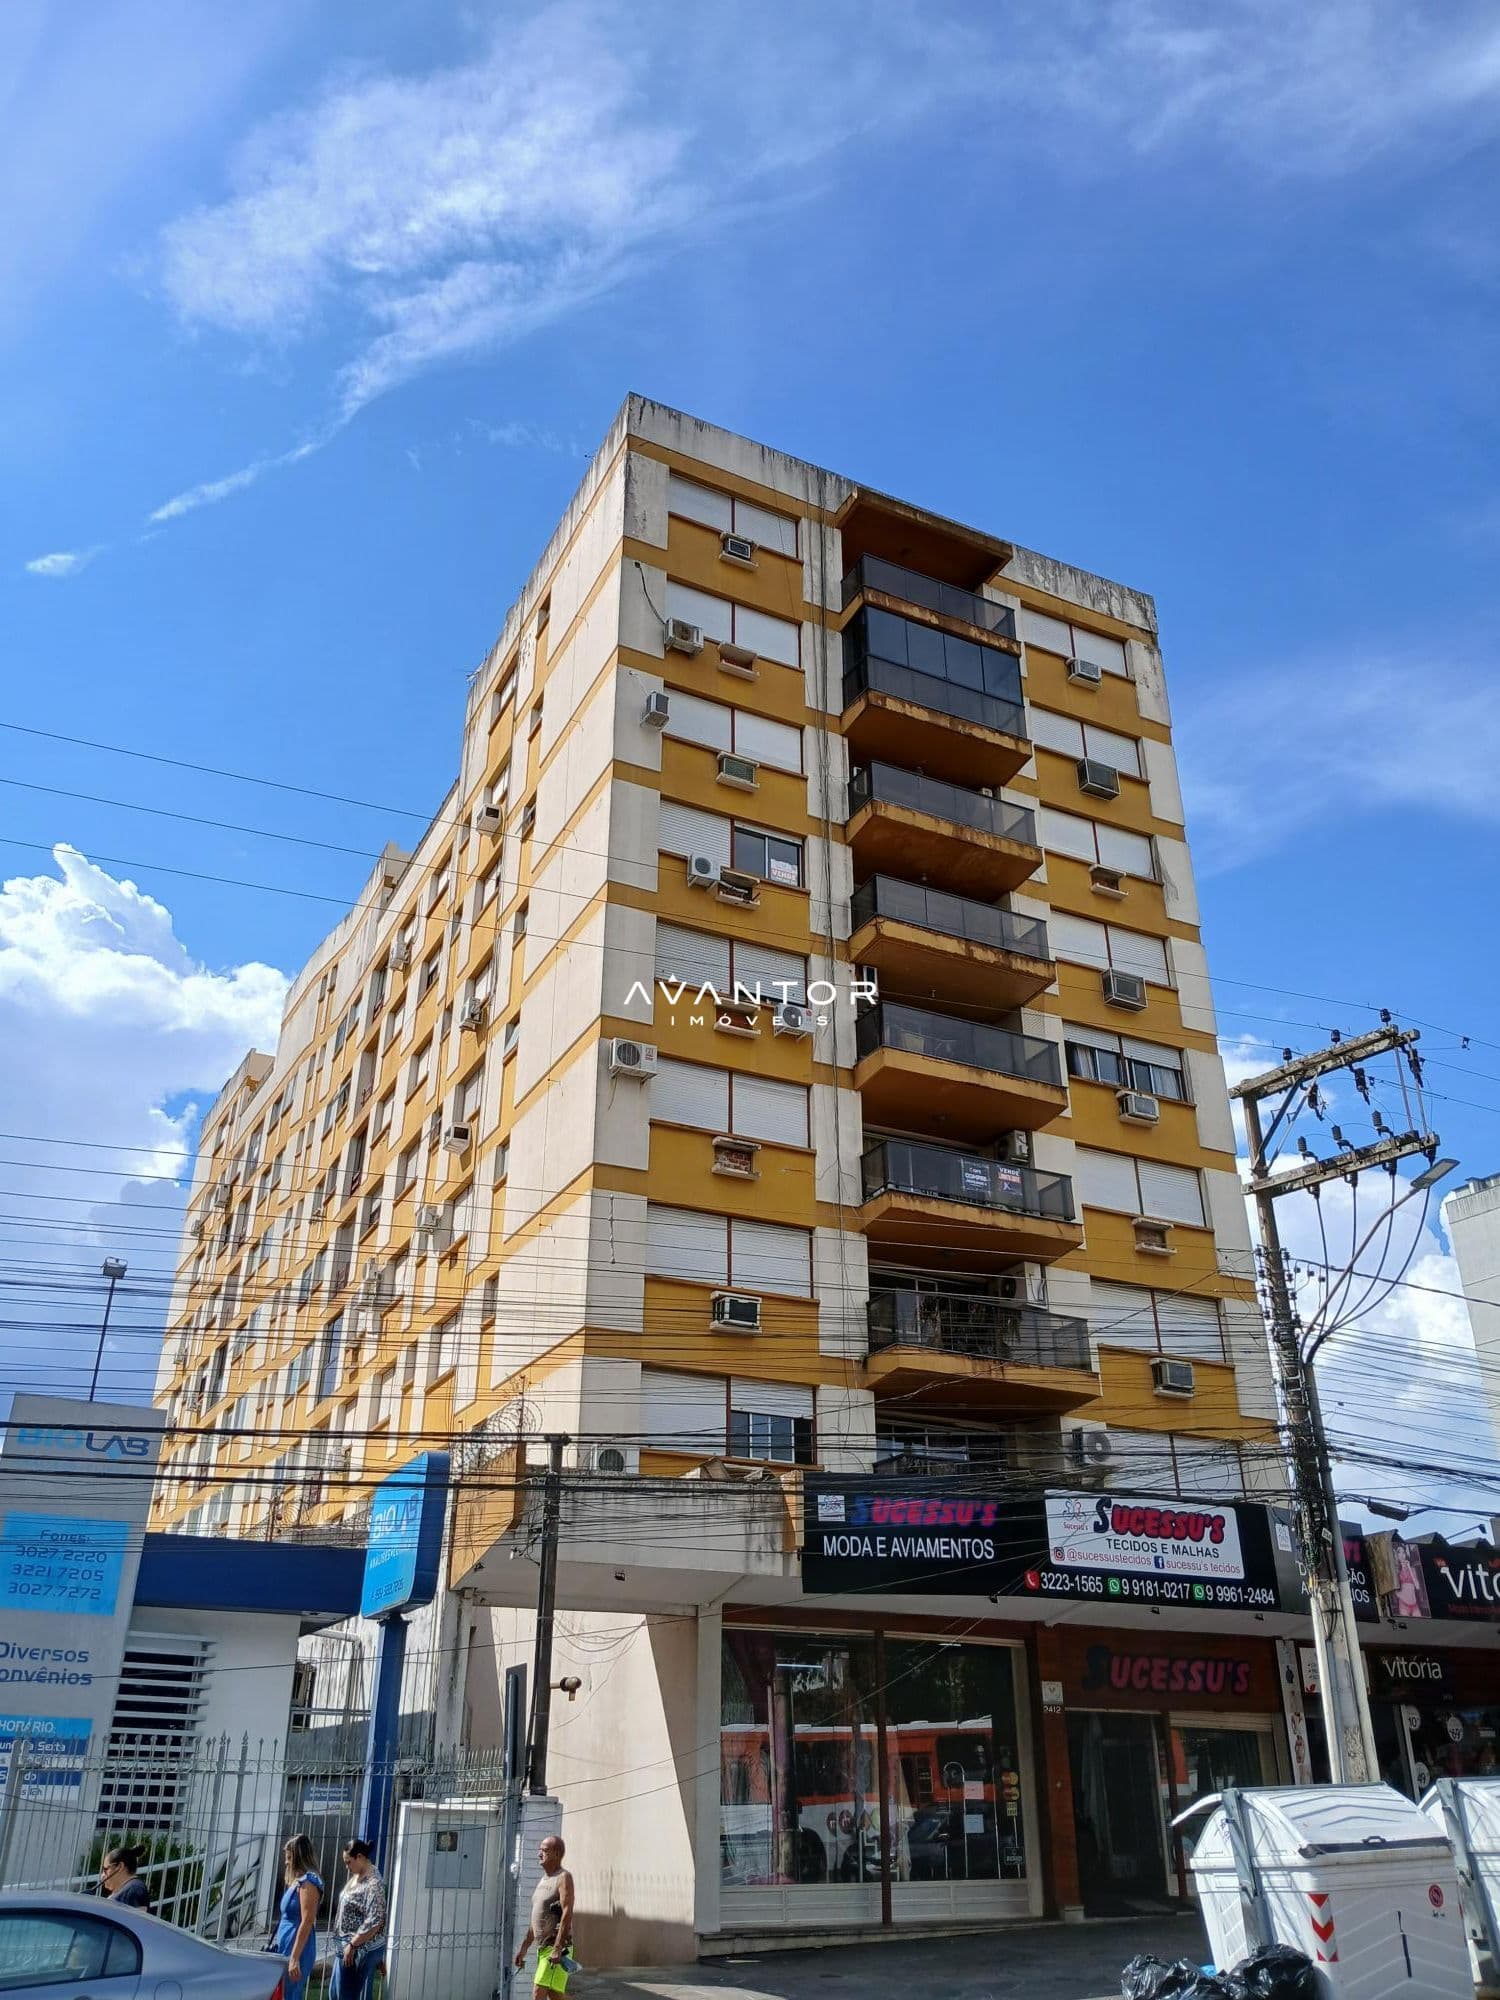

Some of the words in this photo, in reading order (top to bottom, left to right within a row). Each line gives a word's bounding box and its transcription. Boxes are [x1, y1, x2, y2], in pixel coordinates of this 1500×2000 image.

[1094, 1496, 1226, 1544] SUCESSU'S
[823, 1535, 874, 1557] MODA
[877, 1536, 888, 1558] E
[891, 1537, 995, 1560] AVIAMENTOS
[1106, 1537, 1159, 1554] TECIDOS
[1161, 1542, 1169, 1555] E
[1172, 1544, 1220, 1559] MALHAS
[1040, 1571, 1104, 1594] 3223-1565
[1121, 1580, 1130, 1596] 9
[1132, 1580, 1190, 1600] 9181-0217
[1205, 1585, 1214, 1601] 9
[1216, 1584, 1276, 1606] 9961-2484
[0, 1667, 93, 1686] onvênios
[1385, 1656, 1443, 1680] vitória
